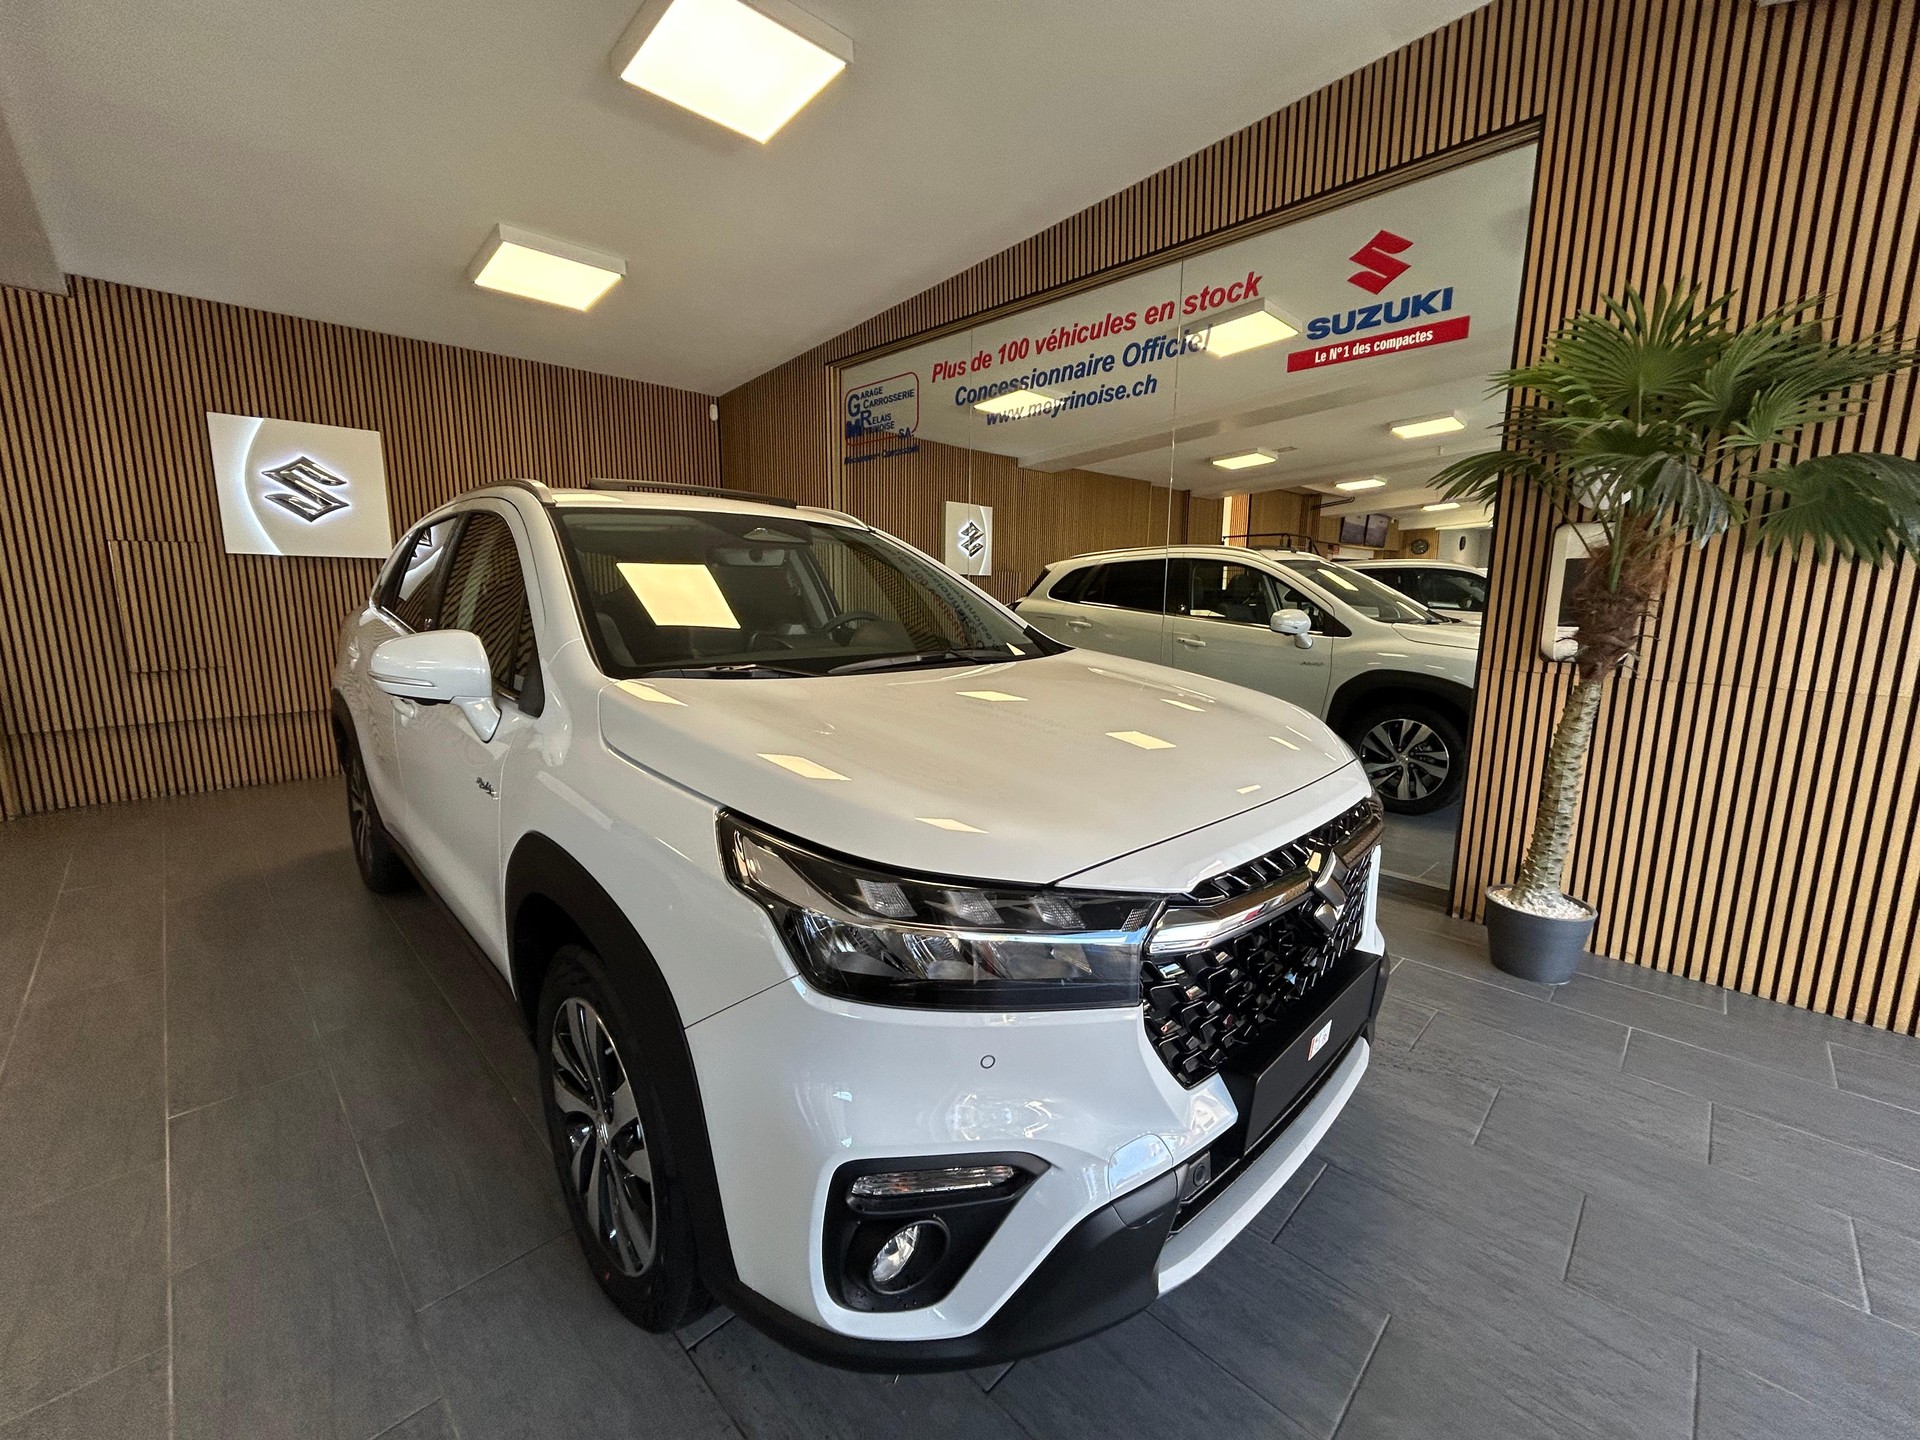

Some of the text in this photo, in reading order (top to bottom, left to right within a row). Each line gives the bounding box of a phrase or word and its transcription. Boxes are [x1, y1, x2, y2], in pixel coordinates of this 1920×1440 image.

[932, 271, 1263, 383] Plus de 100 véhicules en stock
[1306, 287, 1454, 340] SUZUKI
[955, 323, 1214, 407] Concessionnaire Officiel
[1314, 350, 1327, 364] Le
[1352, 342, 1371, 357] des
[1373, 330, 1433, 350] compactes
[860, 409, 892, 426] RELAIS
[863, 389, 915, 409] CARROSSERIE
